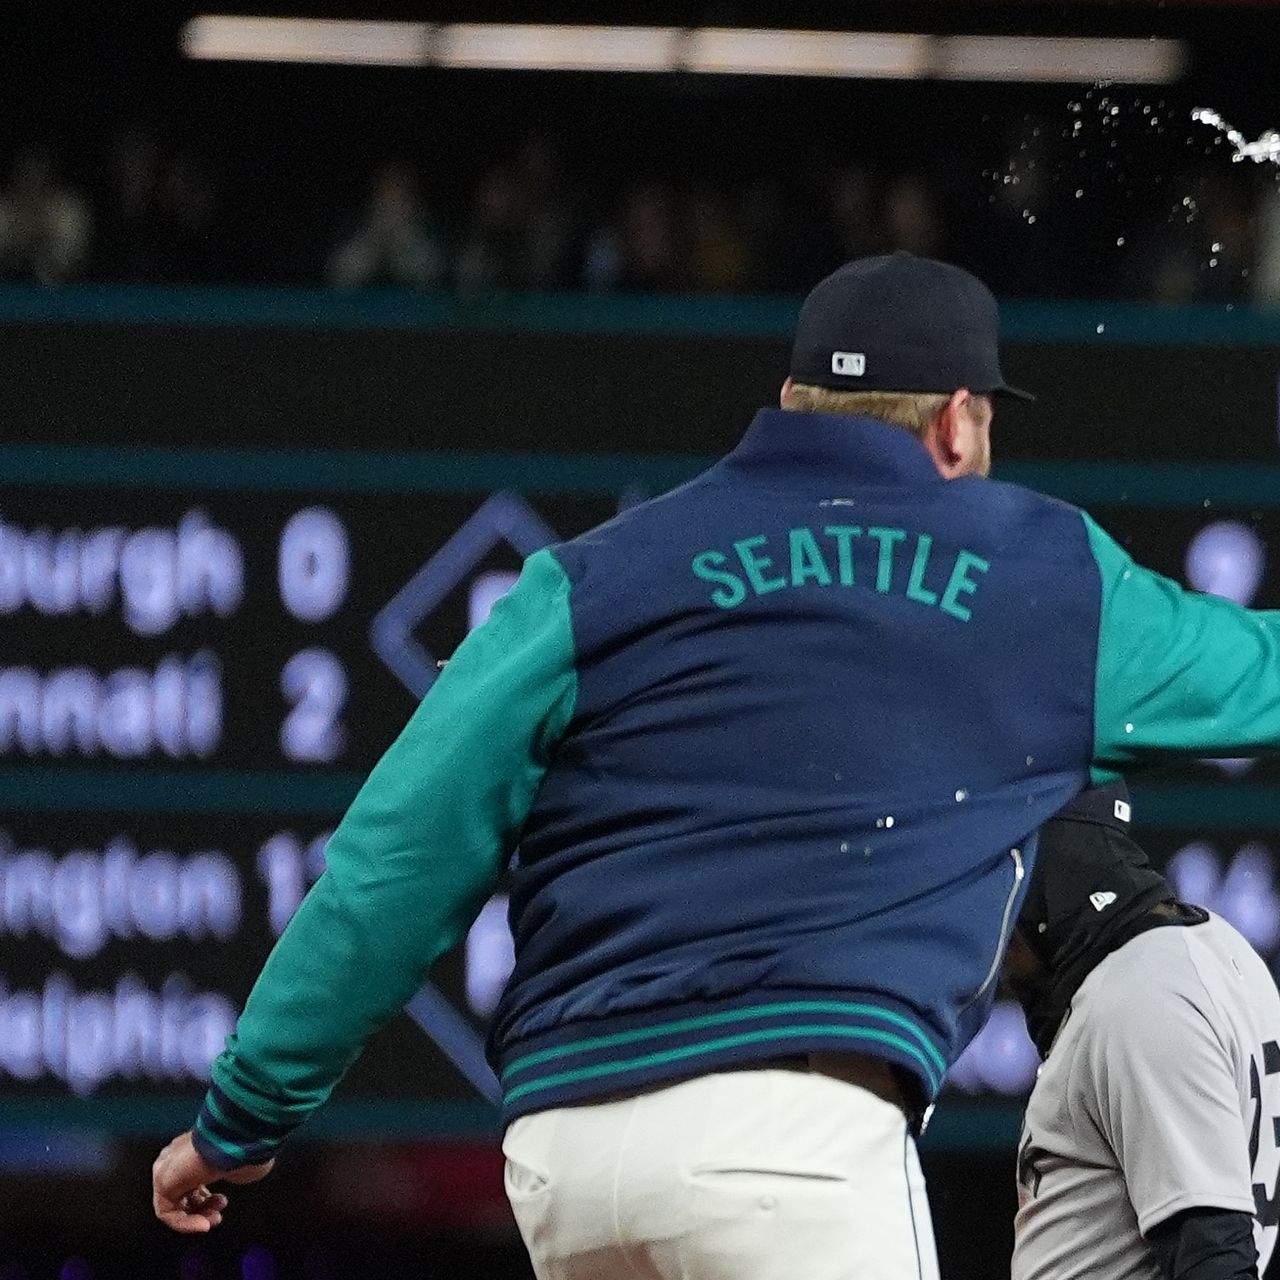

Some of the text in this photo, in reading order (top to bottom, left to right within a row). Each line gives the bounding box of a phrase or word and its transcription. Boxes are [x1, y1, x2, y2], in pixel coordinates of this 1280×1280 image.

[279, 511, 346, 618] 0
[691, 524, 990, 622] SEATTLE
[285, 652, 343, 759] 2
